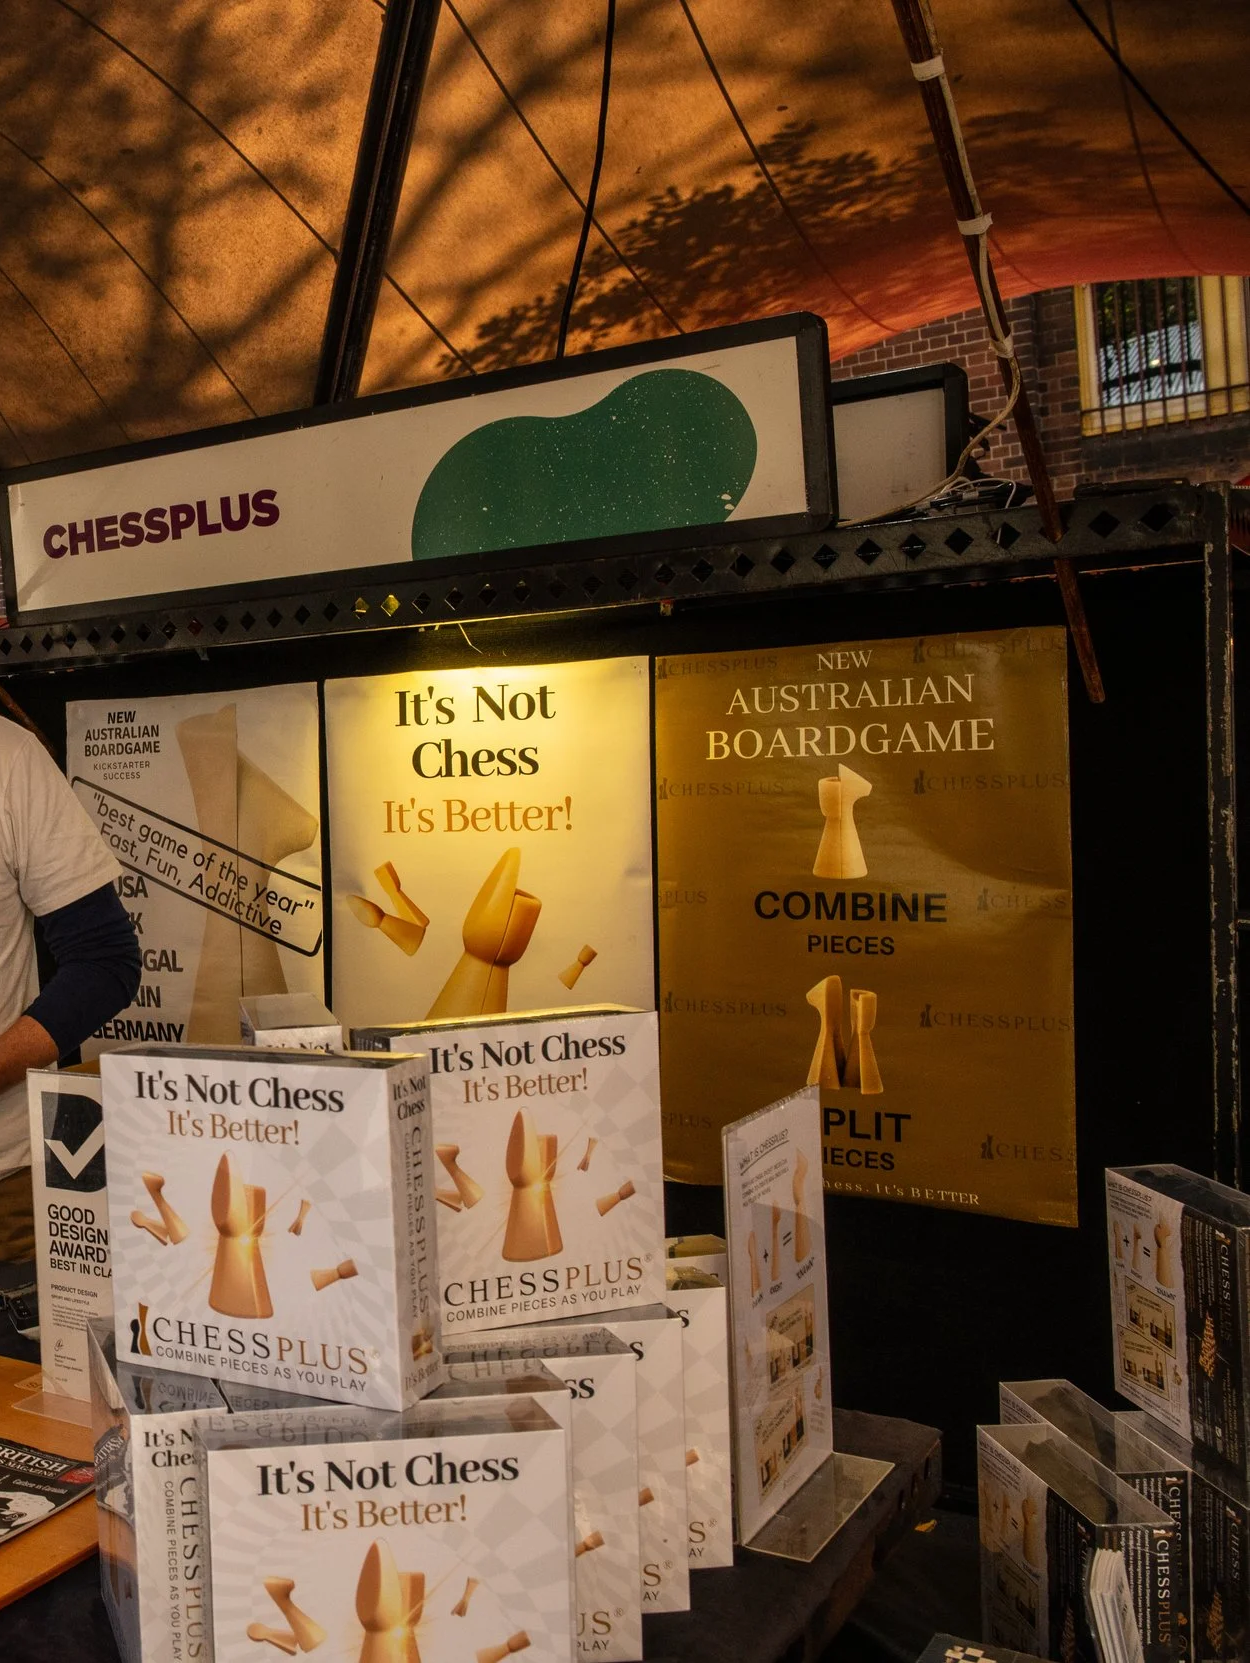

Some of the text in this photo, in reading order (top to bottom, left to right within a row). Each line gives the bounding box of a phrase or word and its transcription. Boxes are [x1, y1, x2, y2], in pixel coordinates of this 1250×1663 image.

[43, 489, 280, 559] CHESSPLUS
[816, 649, 874, 672] NEW
[394, 683, 557, 727] It's Not
[725, 673, 975, 716] AUSTRALIAN
[84, 724, 160, 742] AUSTRALIAN
[107, 710, 136, 724] NEW
[84, 740, 161, 757] BOARDGAME
[705, 718, 995, 761] BOARDGAME
[93, 760, 151, 771] KICKSTARTER
[103, 771, 141, 781] SUCCESS
[412, 738, 539, 779] Chess
[382, 795, 573, 834] It's Better!
[94, 792, 315, 917] "best game of the year"
[100, 822, 283, 936] Fast, Fun, Addictive
[753, 890, 948, 923] COMBINE
[806, 934, 896, 956] PIECES
[430, 1032, 626, 1074] It's Not Chess
[134, 1069, 346, 1114] It's Not Chess
[392, 1075, 426, 1101] It's Not
[462, 1067, 589, 1103] It's Better!
[166, 1109, 300, 1146] It's Better!
[396, 1099, 426, 1121] Chess
[823, 1106, 911, 1143] PLIT
[404, 1132, 413, 1190] COMBINE
[823, 1146, 895, 1171] IECES
[822, 1175, 980, 1206] hess. It's BETTER
[47, 1203, 95, 1225] GOOD
[406, 1192, 415, 1236] PIECES
[411, 1125, 430, 1313] CHESSPLUS
[49, 1220, 109, 1246] DESIGN
[49, 1239, 107, 1264] AWARD
[50, 1258, 78, 1273] BEST
[79, 1262, 91, 1275] IN
[409, 1258, 417, 1282] YOU
[50, 1283, 98, 1298] PRODUCT DESIGN
[446, 1284, 642, 1323] COMBINE PIECES AS YOU PLAY
[155, 1344, 367, 1393] COMBINE PIECES AS YOU PLAY
[405, 1371, 418, 1392] It's
[143, 1428, 176, 1448] It's
[5, 1460, 58, 1478] MAGAZINE
[256, 1451, 520, 1497] It's Not Chess
[300, 1493, 468, 1532] It's Better!
[164, 1480, 182, 1663] COMBINE PIECES AS YOU PLAY
[179, 1476, 205, 1658] CHESSPLUS
[1155, 1539, 1171, 1643] CHESSPLUS
